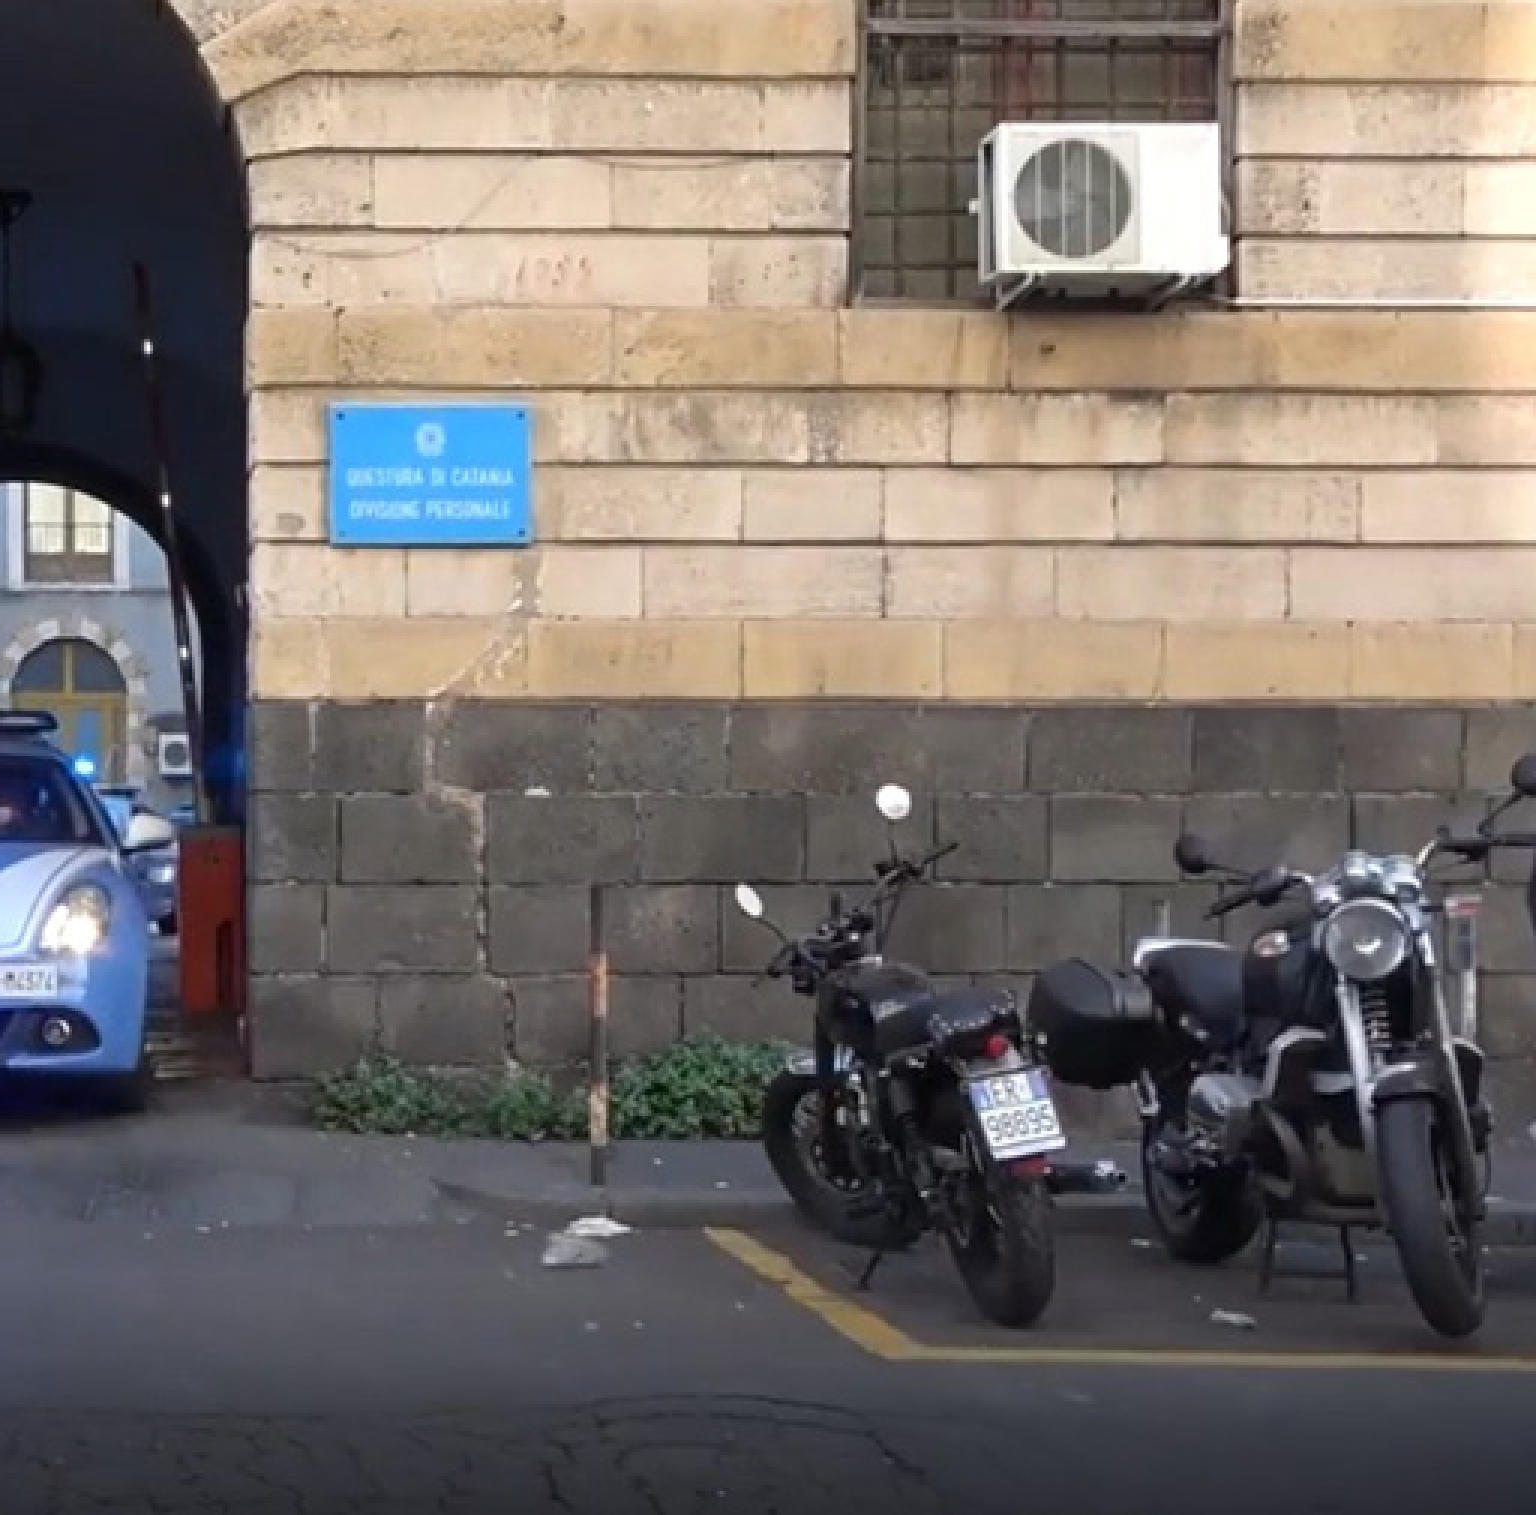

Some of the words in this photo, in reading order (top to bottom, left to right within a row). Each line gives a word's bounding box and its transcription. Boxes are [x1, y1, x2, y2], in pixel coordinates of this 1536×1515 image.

[346, 467, 424, 487] QUESTURA
[431, 467, 445, 487] DI
[450, 467, 514, 487] CATANIA
[349, 499, 421, 520] DIVISIONE
[425, 499, 511, 520] PERSONALE
